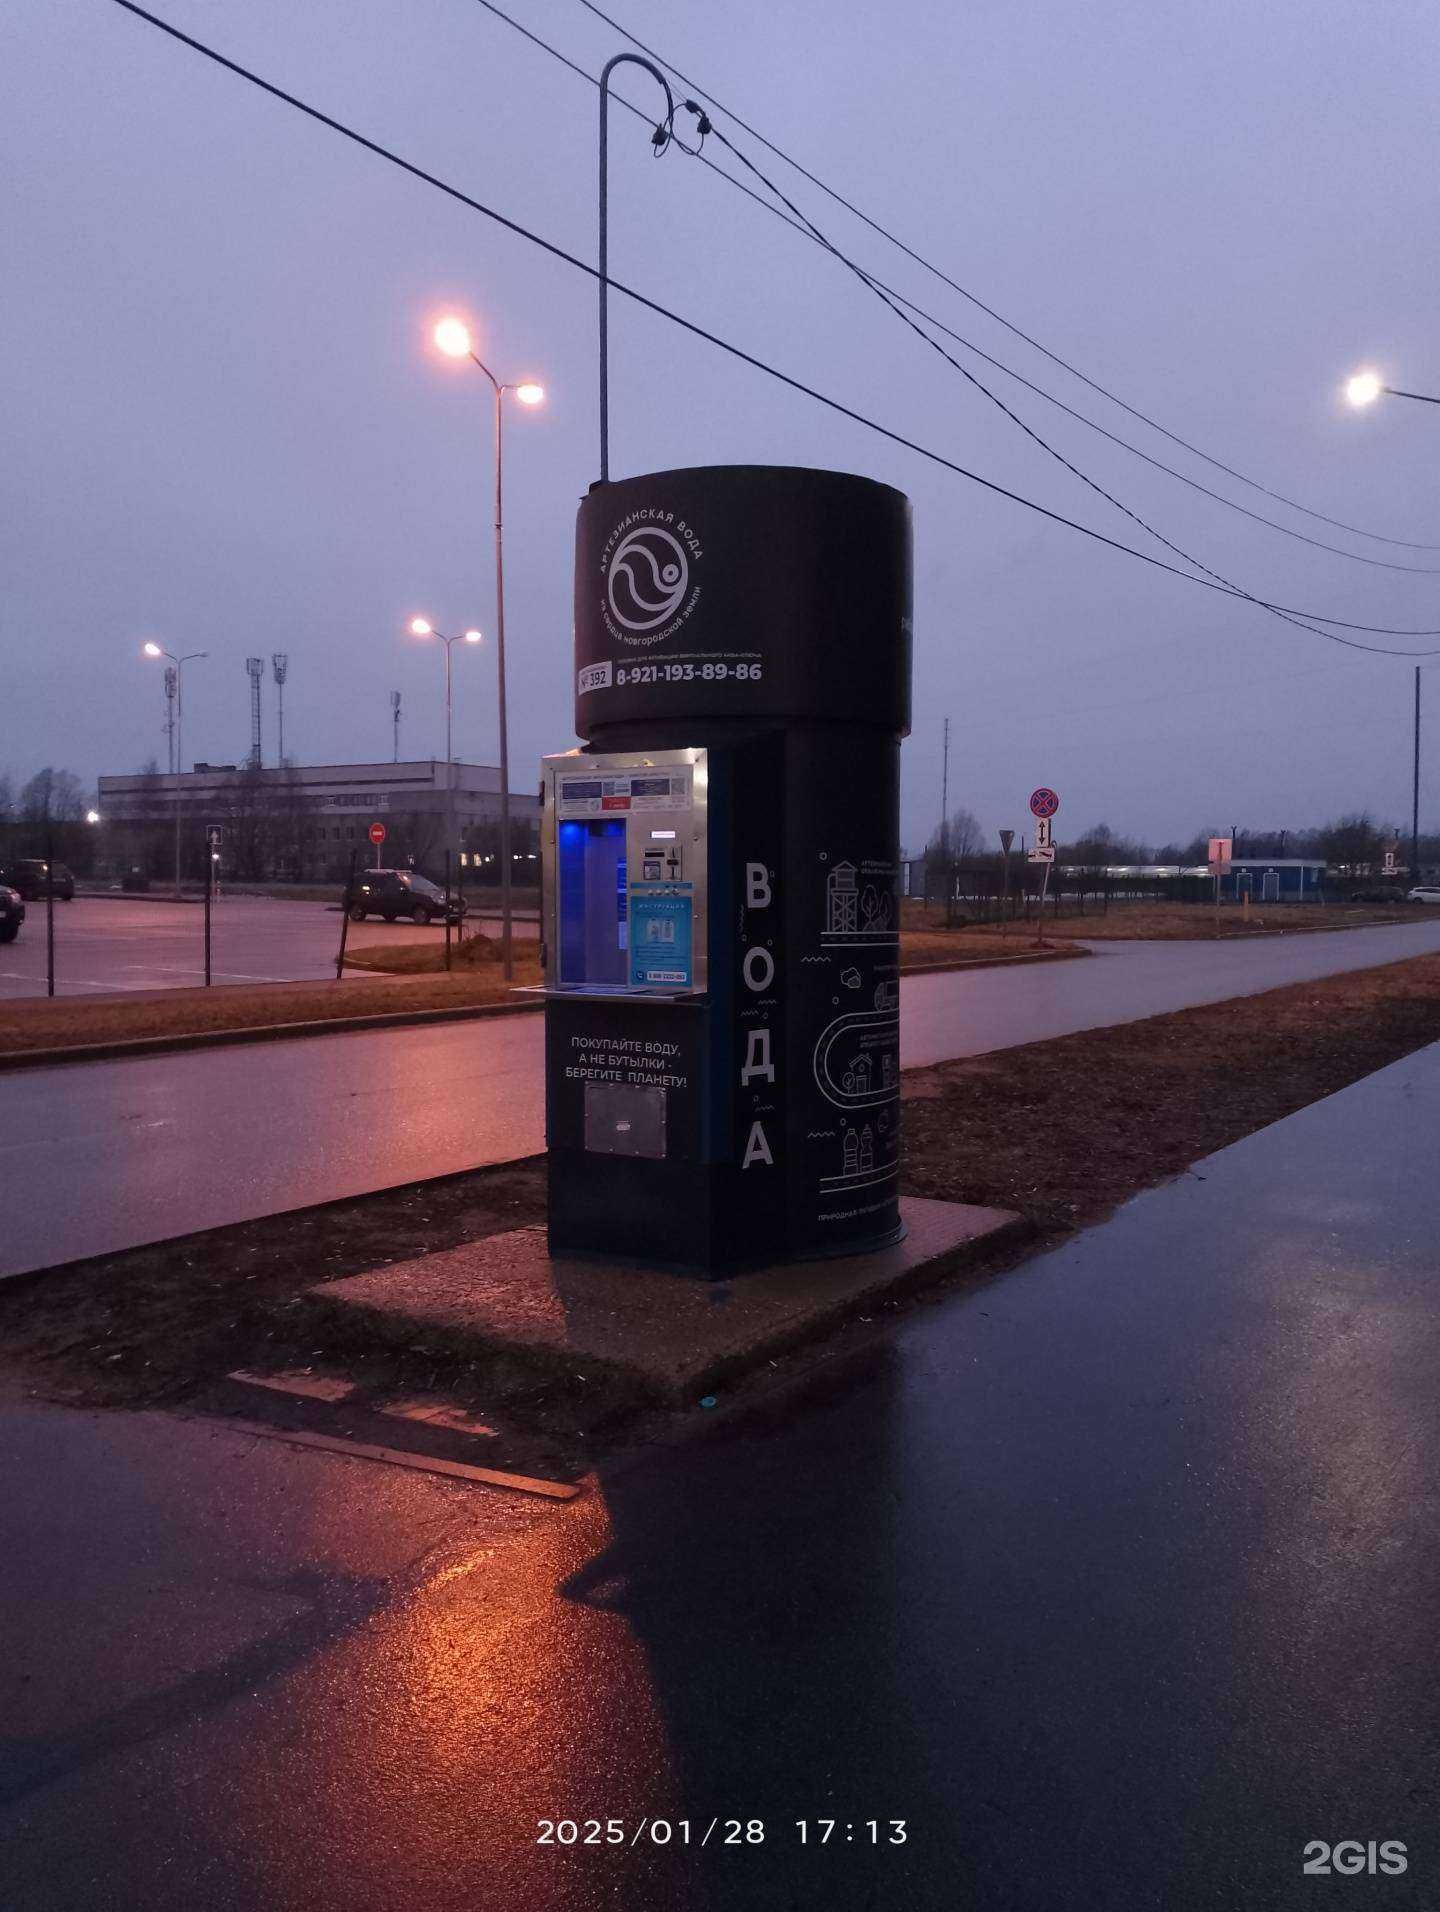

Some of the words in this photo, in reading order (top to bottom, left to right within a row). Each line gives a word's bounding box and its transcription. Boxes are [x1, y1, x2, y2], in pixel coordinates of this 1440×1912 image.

[600, 508, 674, 574] АРТЕЗИАНСКАЯ
[677, 520, 704, 560] ВОДА
[590, 671, 606, 687] 392
[616, 663, 763, 686] 8-921-193-89-86
[741, 862, 775, 1169] ВОДА
[571, 1037, 642, 1052] ПОКУПАЙТЕ
[645, 1042, 680, 1056] ВОДУ,
[579, 1053, 587, 1063] А
[590, 1054, 605, 1065] НЕ
[608, 1055, 665, 1069] БУТЫЛКИ
[566, 1067, 622, 1081] БЕРЕГИТЕ
[628, 1072, 687, 1088] ПЛАНЕТУ!
